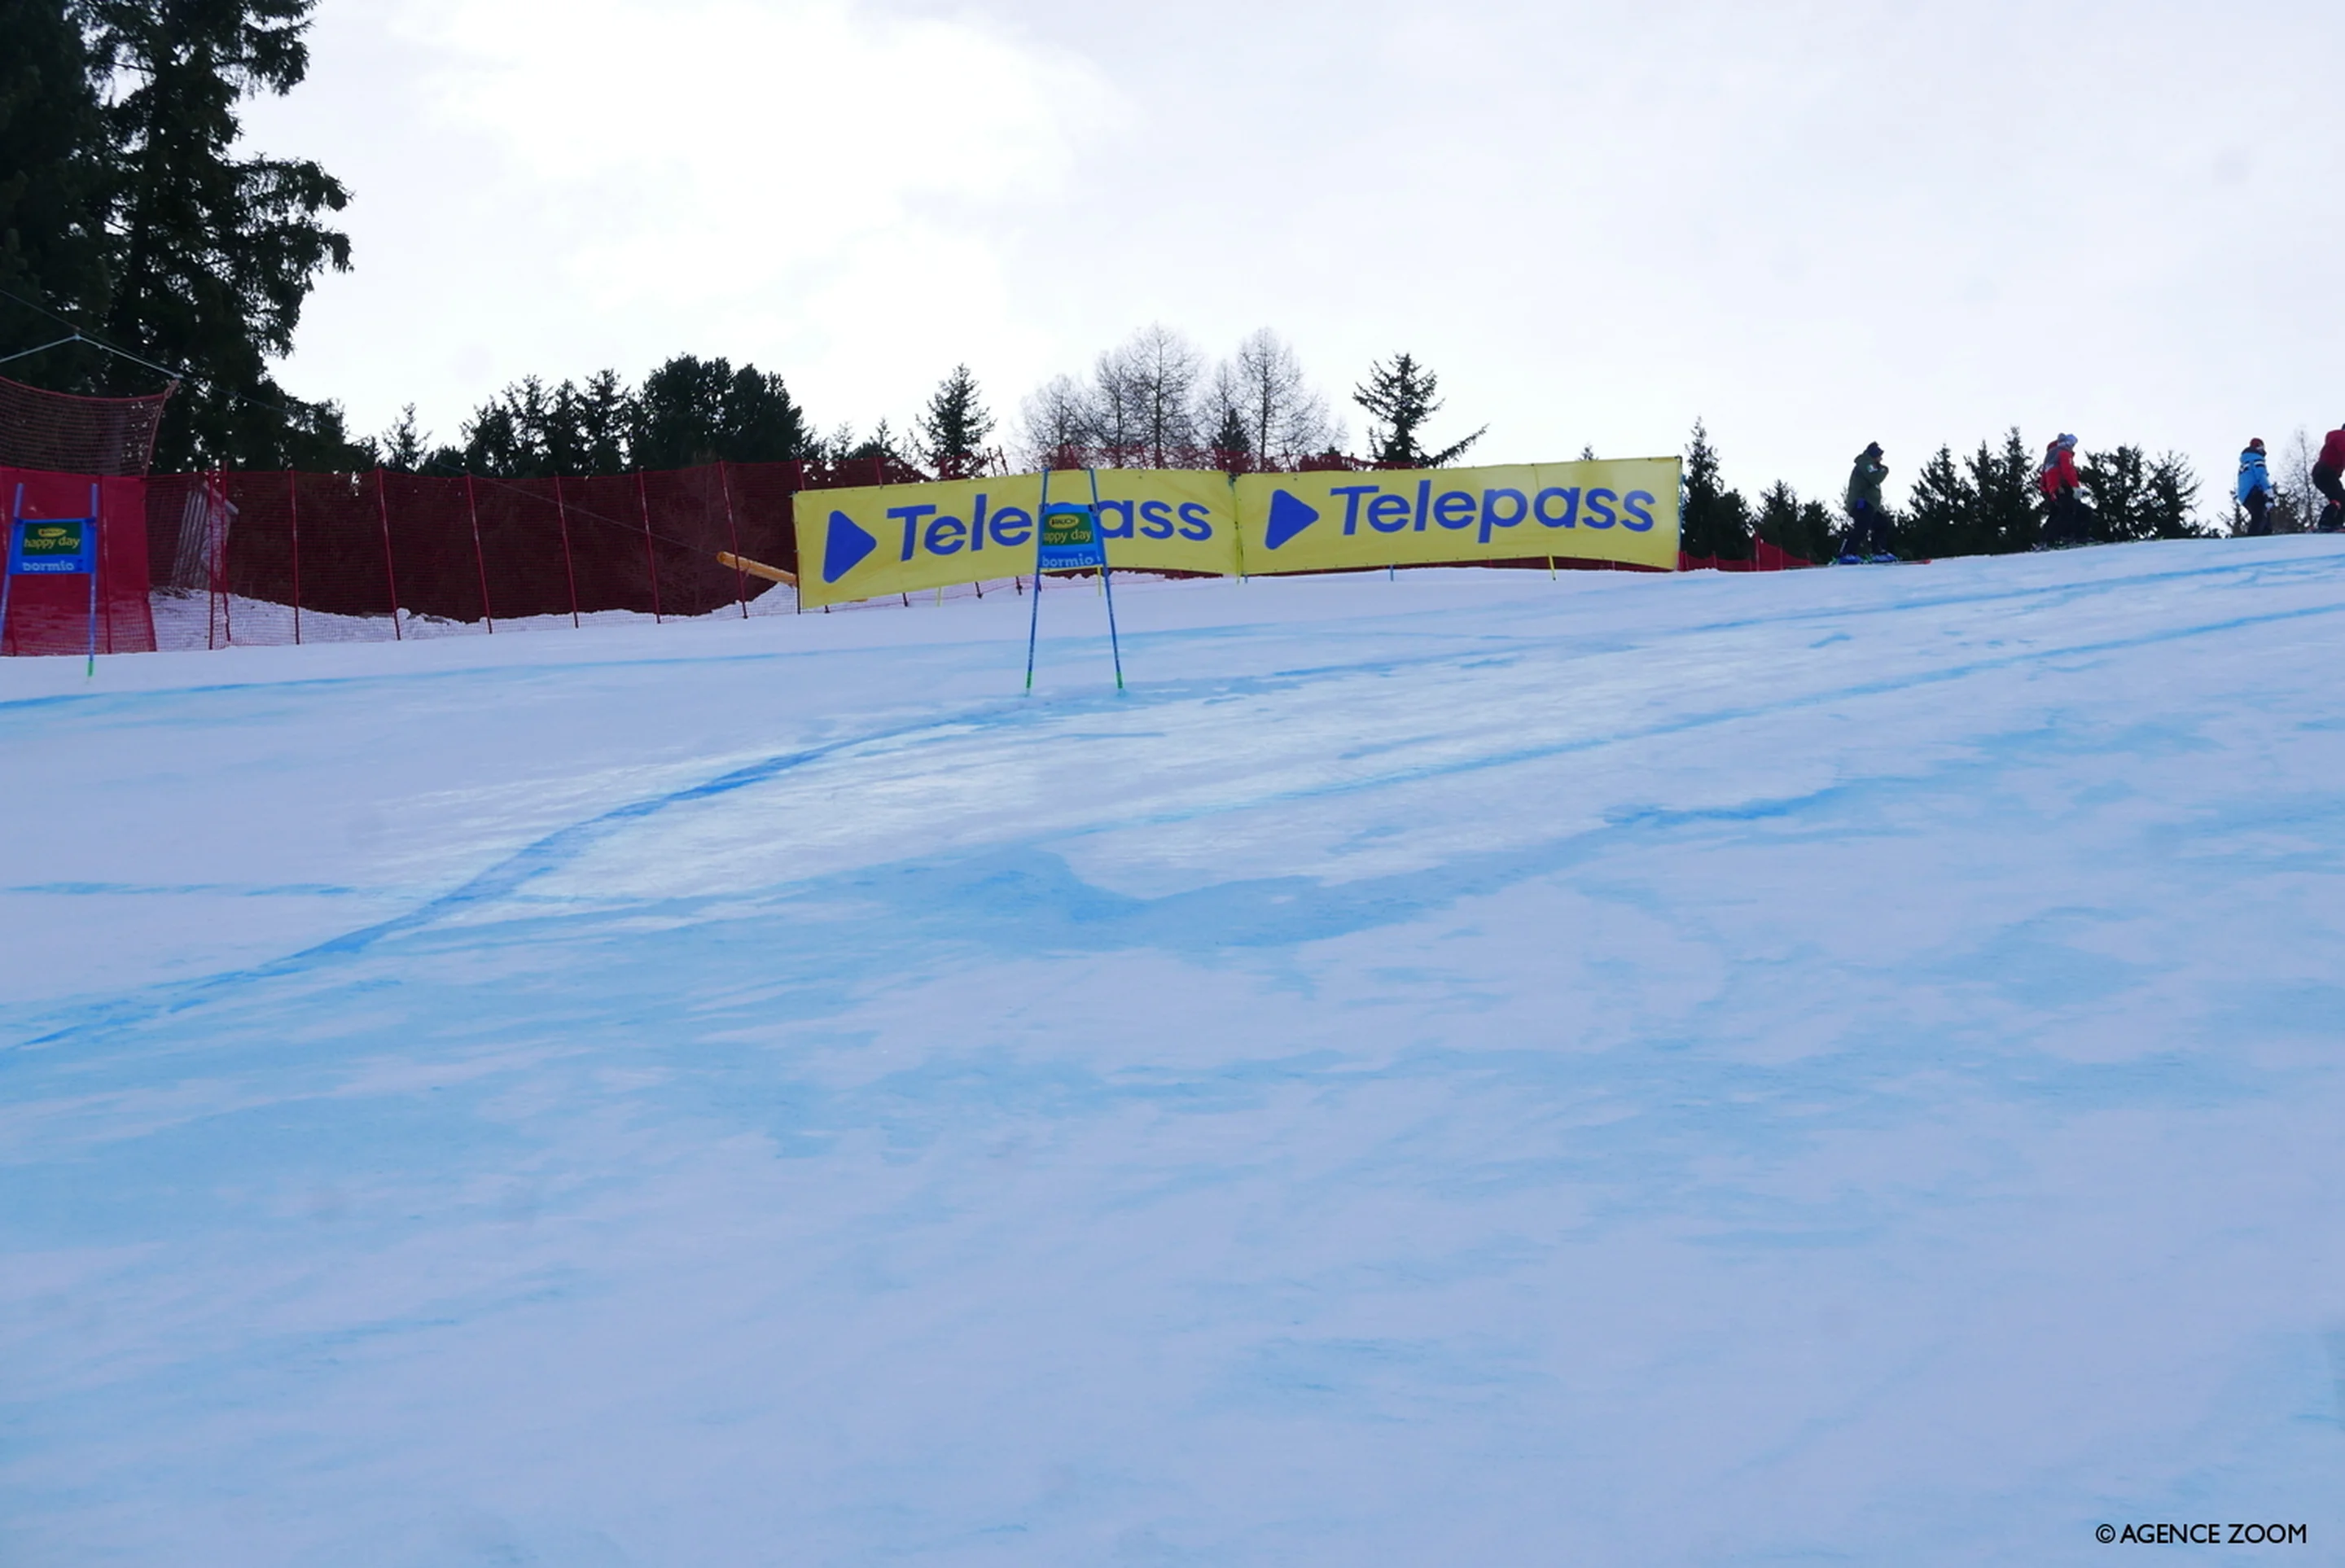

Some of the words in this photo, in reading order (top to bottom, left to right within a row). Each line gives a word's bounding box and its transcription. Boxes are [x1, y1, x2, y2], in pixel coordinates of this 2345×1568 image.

[1330, 479, 1655, 544] Telepass
[887, 493, 1213, 562] Teleass
[24, 537, 56, 550] happy
[58, 536, 81, 550] day
[1043, 532, 1068, 545] appy
[1071, 528, 1092, 543] day
[1042, 553, 1094, 567] bormio
